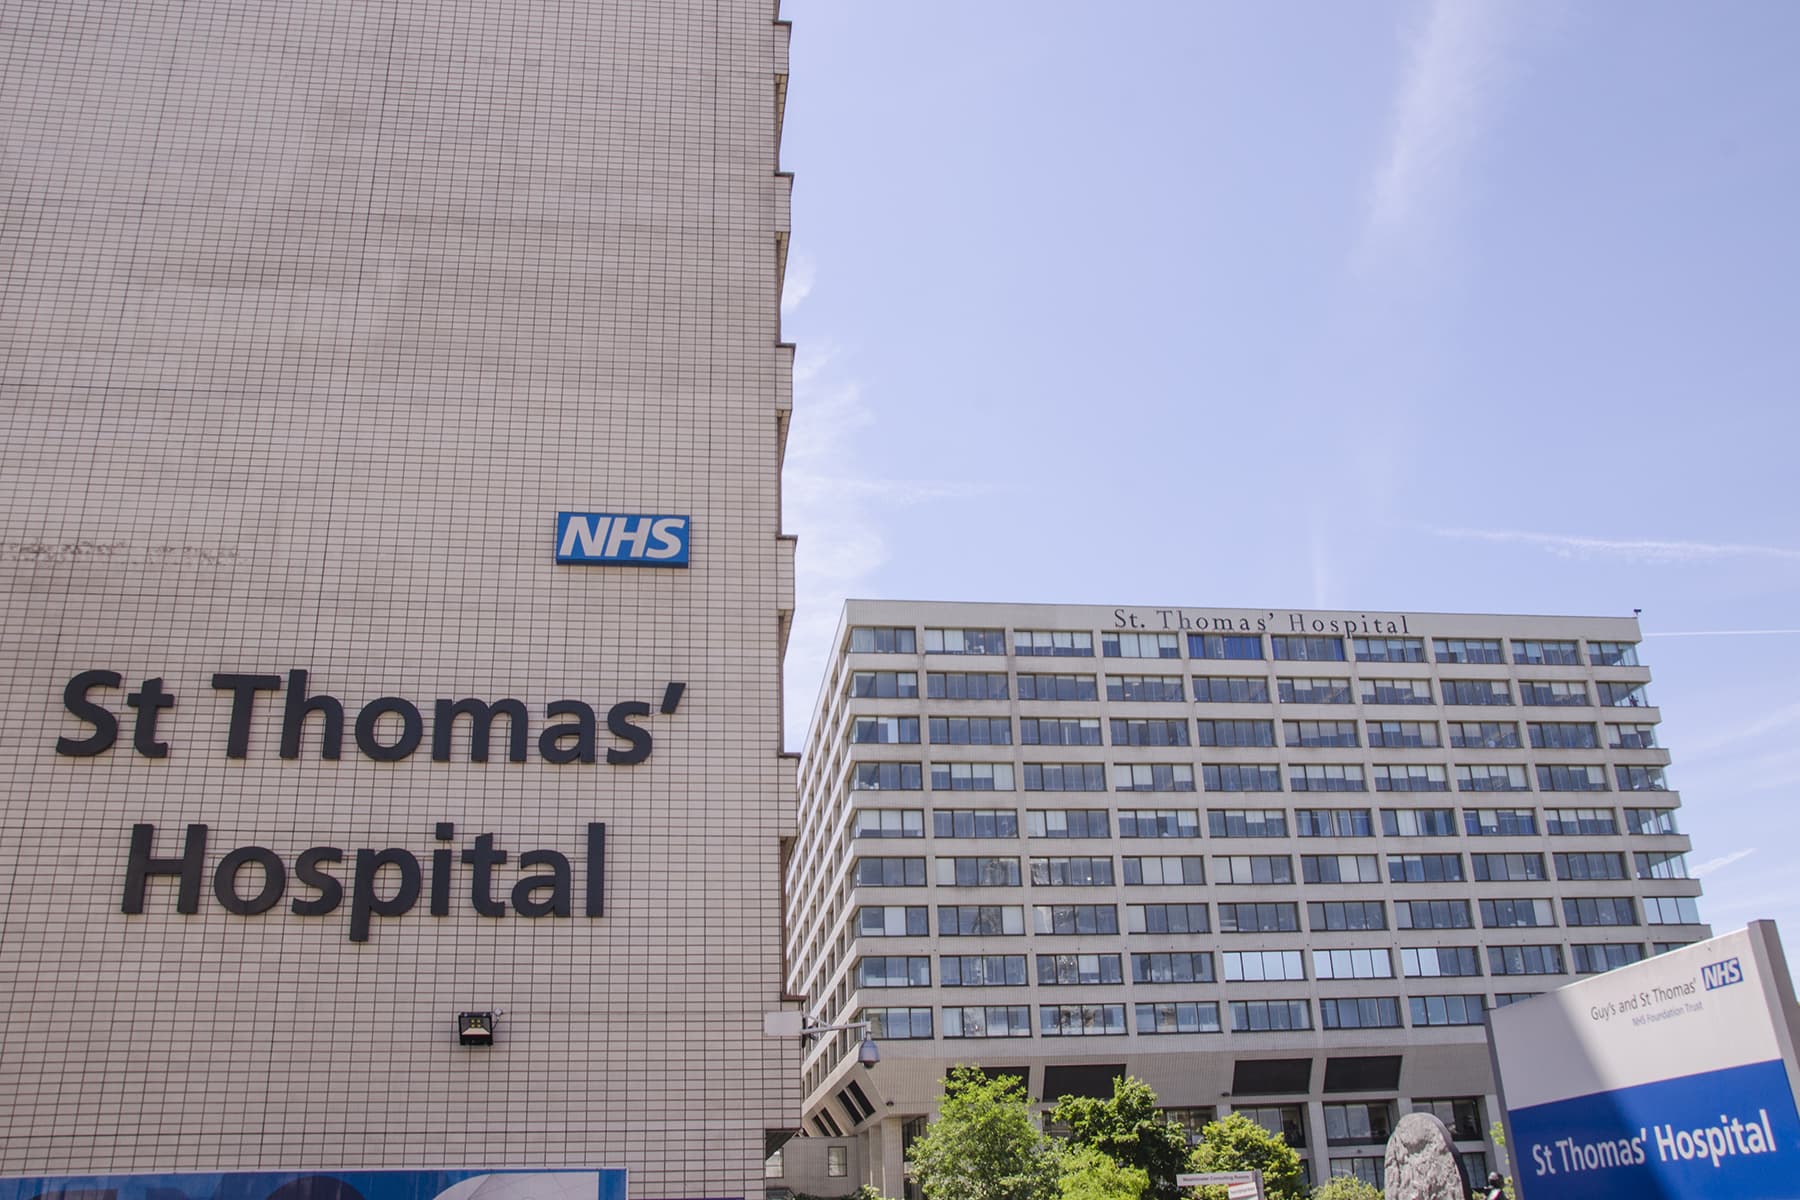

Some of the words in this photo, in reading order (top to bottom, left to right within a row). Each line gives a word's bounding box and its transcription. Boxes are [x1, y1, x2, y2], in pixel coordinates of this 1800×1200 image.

[559, 515, 686, 560] NHS
[1114, 608, 1146, 629] St.
[1289, 613, 1410, 640] Hospital
[56, 669, 175, 759] St
[212, 669, 687, 765] Thomas'
[121, 822, 606, 942] Hospital
[1704, 959, 1743, 990] NHS
[1590, 1002, 1617, 1021] Guy's
[1618, 994, 1638, 1013] and
[1639, 992, 1652, 1007] St
[1651, 977, 1697, 1004] Thomas'
[1632, 1015, 1646, 1026] NHS
[1646, 1007, 1685, 1023] Foundation
[1684, 1000, 1704, 1013] Trust
[1532, 1143, 1556, 1176] St
[1555, 1127, 1647, 1174] Thomas'
[1653, 1109, 1777, 1167] Hospital
